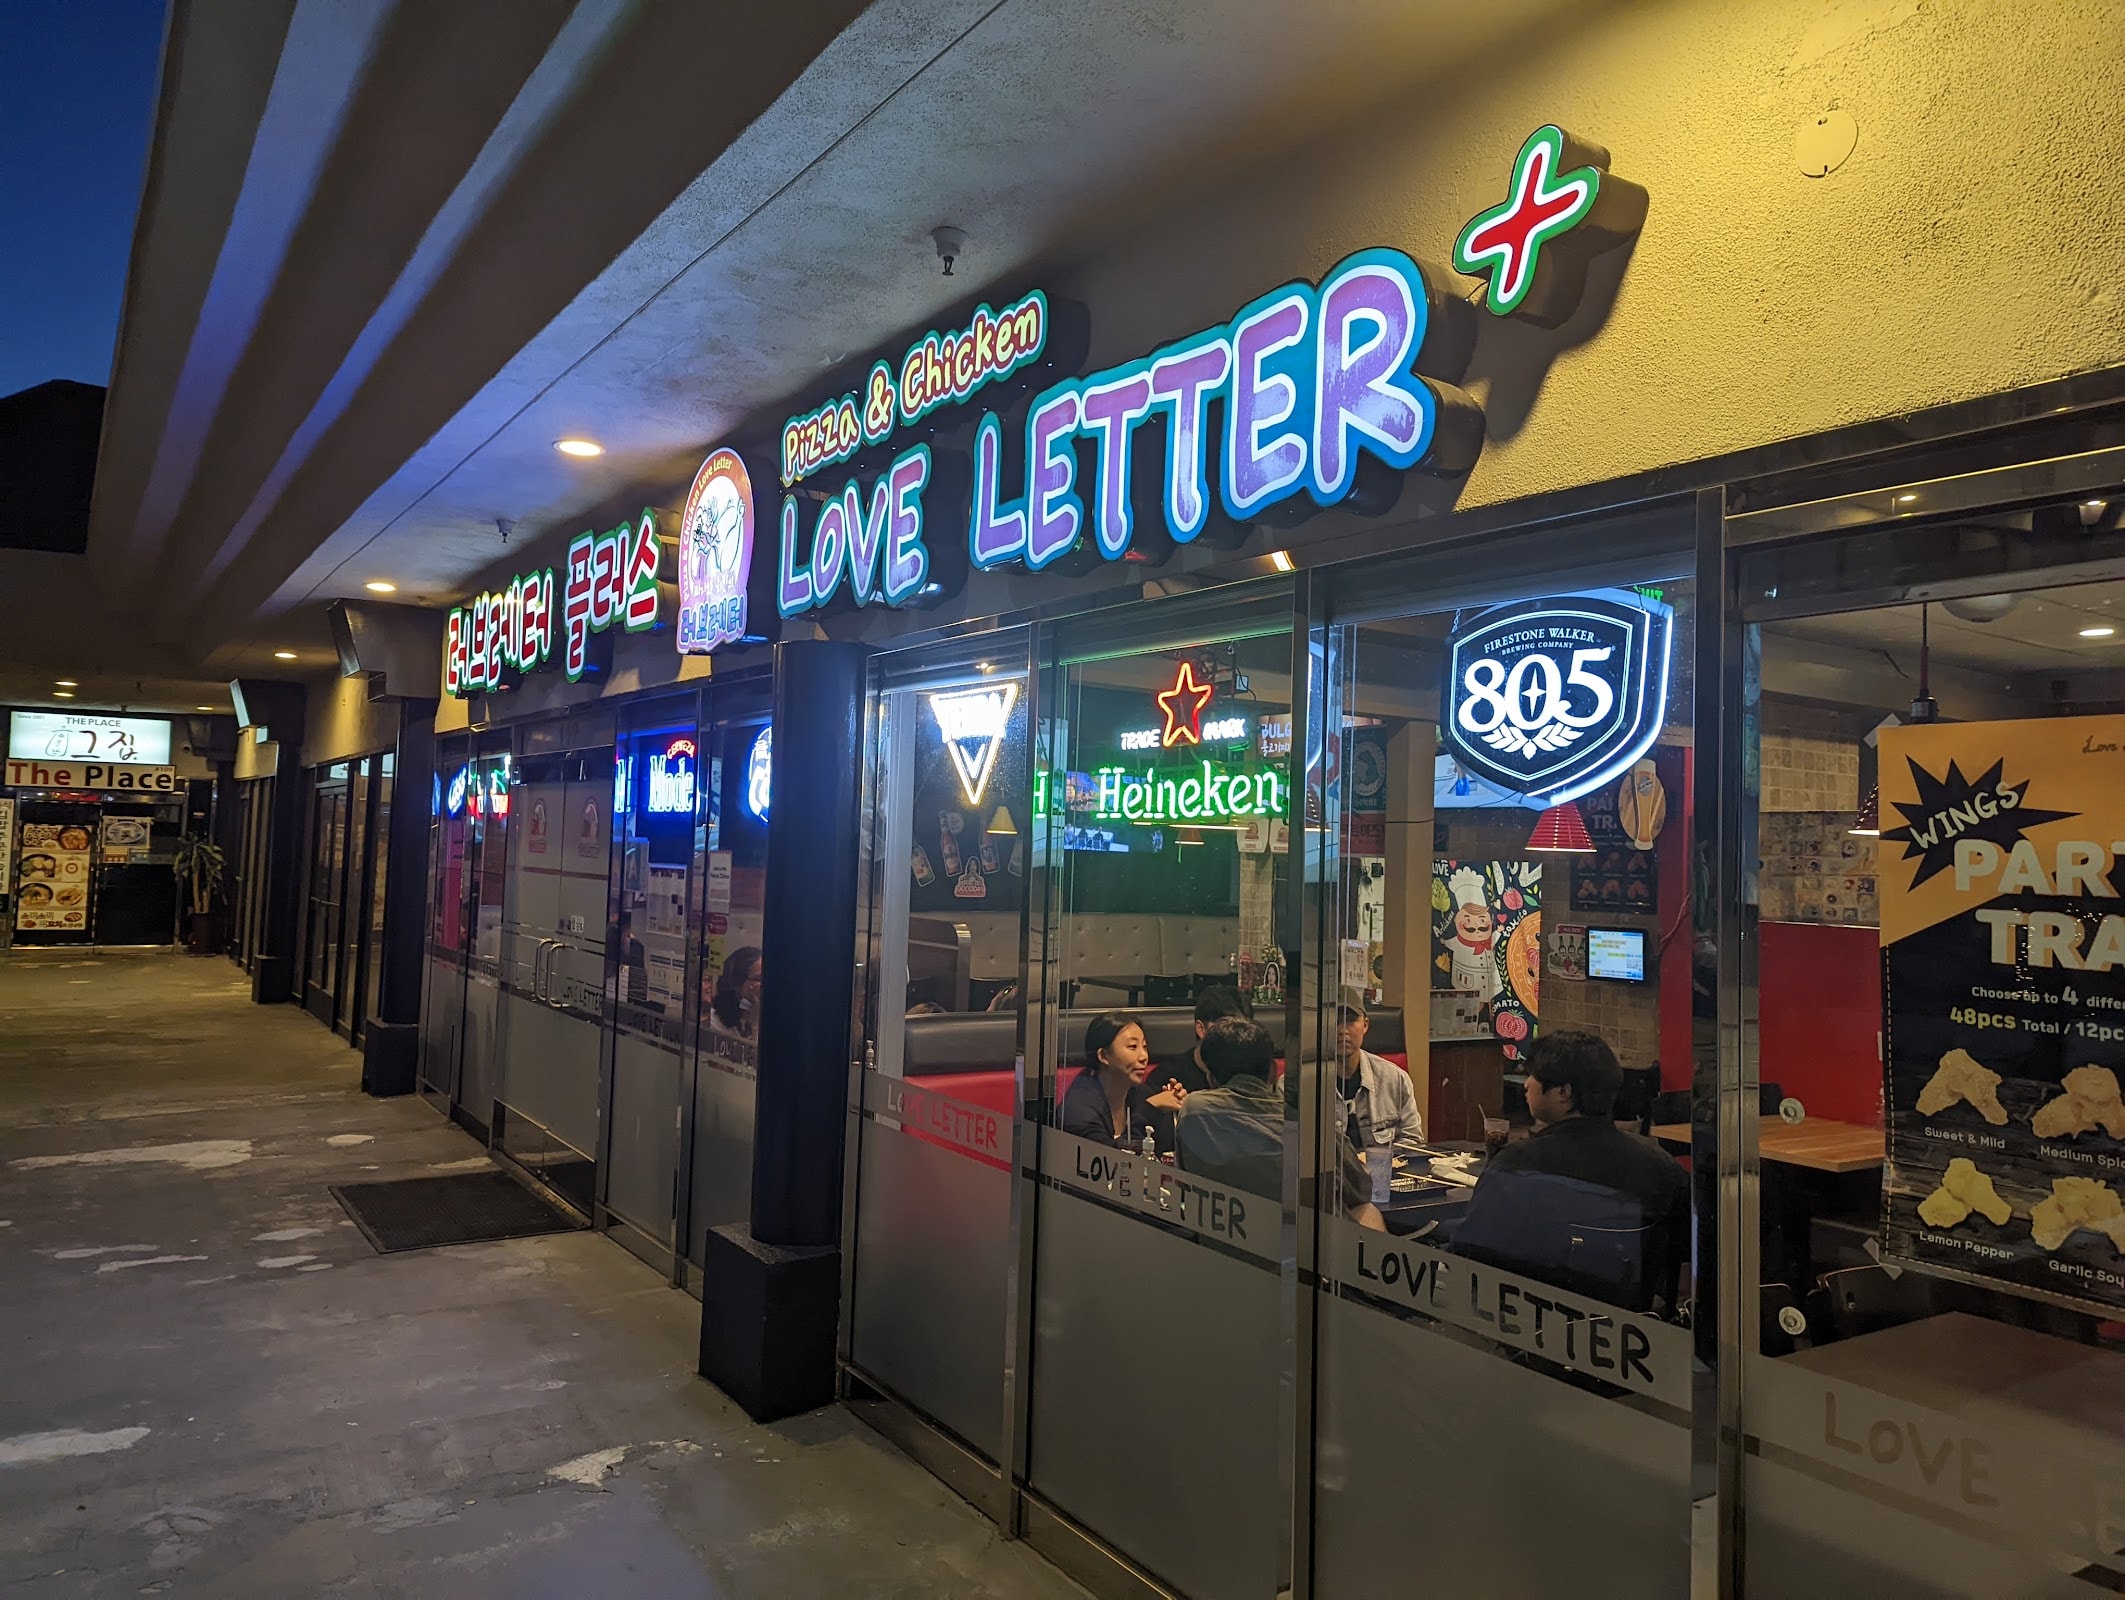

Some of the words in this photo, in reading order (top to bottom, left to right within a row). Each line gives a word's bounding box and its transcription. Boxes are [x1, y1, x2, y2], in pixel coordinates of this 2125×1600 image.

[783, 400, 860, 480] Pizza
[865, 367, 896, 438] &
[902, 296, 1043, 420] Chicken
[779, 447, 928, 615] LOVE
[972, 252, 1432, 568] LETTER
[698, 466, 713, 489] Love
[713, 455, 732, 473] Letter
[446, 567, 554, 695] 러브레터
[565, 507, 661, 682] 플러스
[680, 596, 744, 644] 러브레터
[1484, 628, 1545, 654] FIRESTONE
[1548, 627, 1596, 643] WALKER
[1501, 642, 1536, 656] BREWING
[1537, 641, 1574, 650] COMPANY
[1458, 647, 1613, 734] 805
[65, 716, 87, 726] THE
[88, 718, 121, 727] PLACE
[1120, 728, 1161, 750] TRADE
[1202, 717, 1246, 741] MARK
[667, 739, 695, 760] CERVEZA
[2081, 734, 2119, 754] Love
[8, 762, 72, 786] The
[84, 765, 172, 790] Place
[1096, 760, 1283, 820] Heineken
[1909, 780, 2020, 849] WINGS
[1492, 999, 1520, 1015] OMATO
[1971, 986, 2021, 1000] Choose
[2043, 992, 2059, 1004] to
[2062, 985, 2079, 1005] 4
[1950, 1006, 2016, 1029] 48pcs
[2022, 1019, 2060, 1034] Total
[887, 1083, 925, 1124] LOVE
[932, 1104, 998, 1151] LETTER
[1924, 1126, 1964, 1143] Sweet
[1967, 1134, 1976, 1144] &
[1980, 1137, 2006, 1149] Mild
[2040, 1145, 2093, 1163] Medium
[1075, 1145, 1132, 1197] LOVE
[1142, 1166, 1247, 1241] LETTER
[1919, 1230, 1962, 1249] Lemon
[1964, 1241, 2014, 1260] Pepper
[2049, 1259, 2093, 1279] Garlic
[2097, 1269, 2125, 1290] Soy
[1357, 1239, 1450, 1308] LOVE
[1471, 1272, 1654, 1384] LETTER
[1825, 1391, 2001, 1507] LOVE
